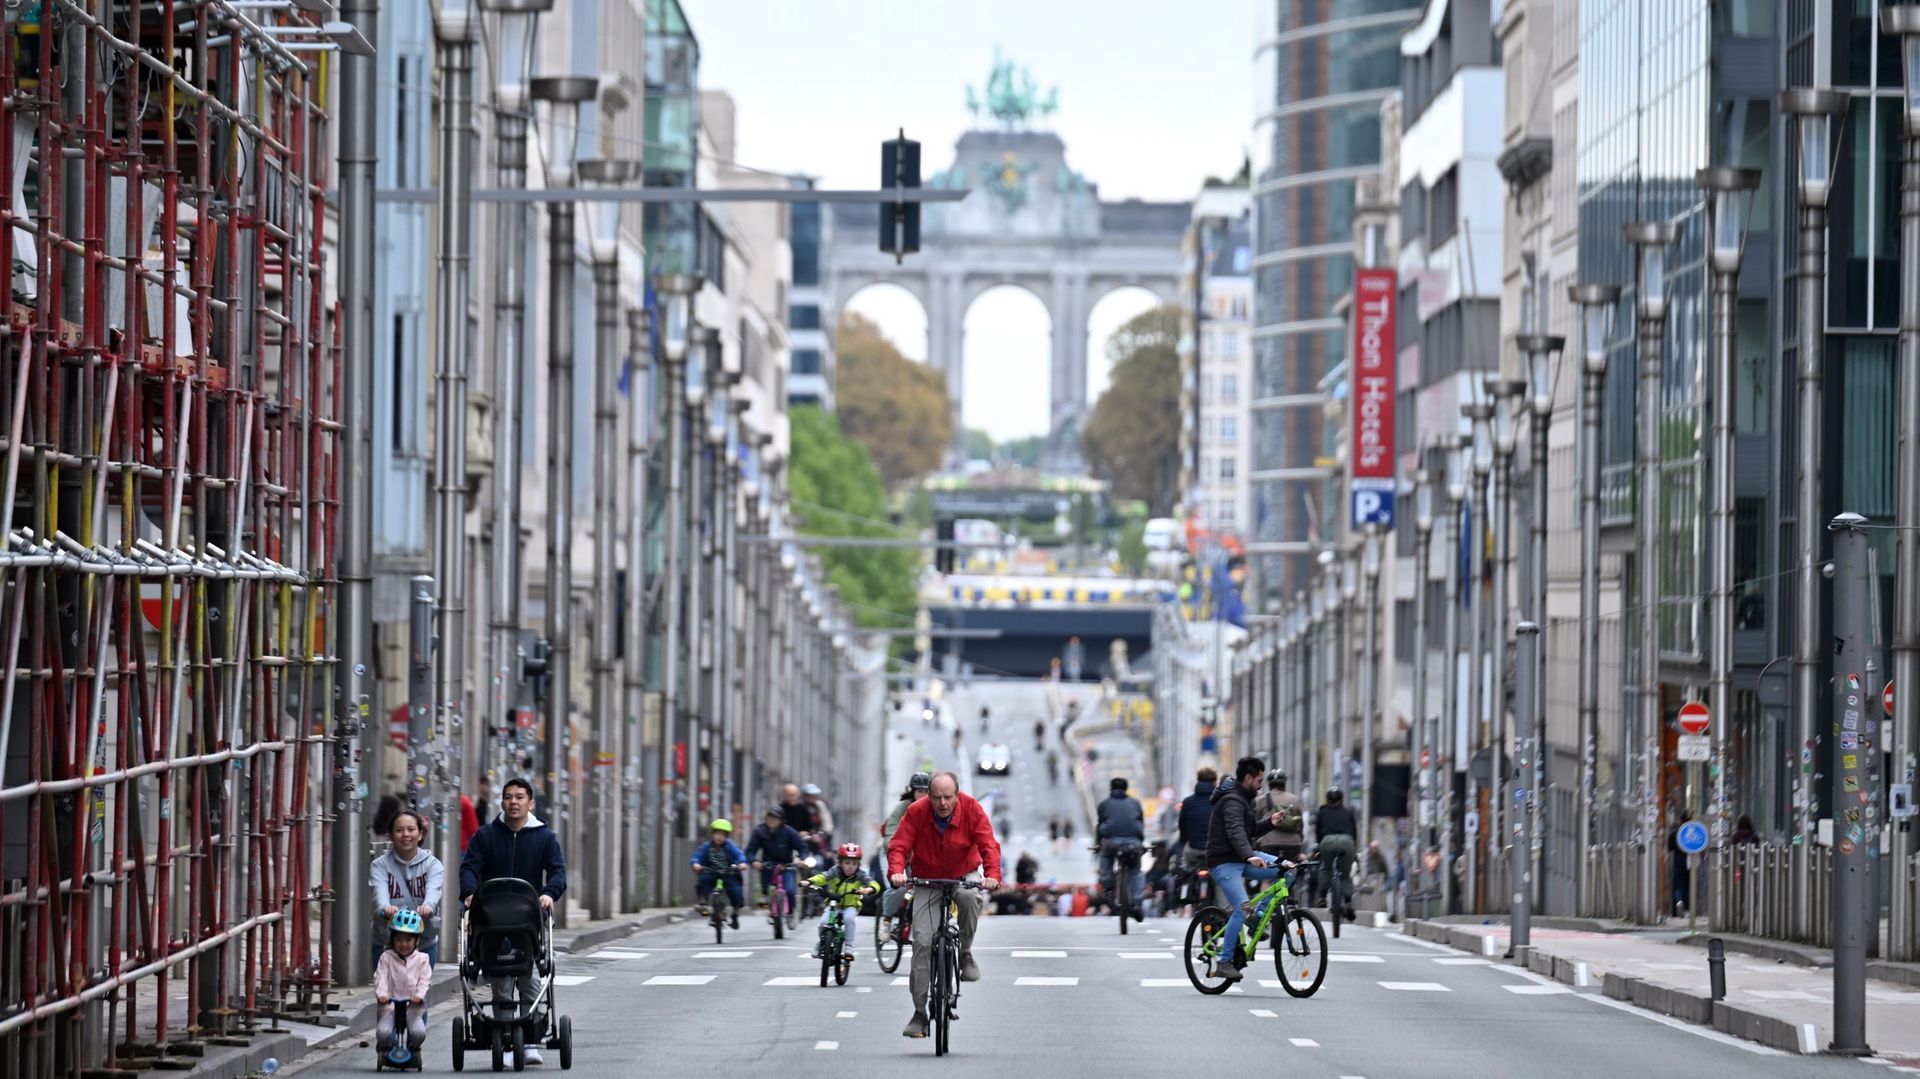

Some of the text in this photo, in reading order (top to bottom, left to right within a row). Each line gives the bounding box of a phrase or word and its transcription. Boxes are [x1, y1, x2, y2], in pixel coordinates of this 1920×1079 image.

[1362, 295, 1389, 369] Thon
[1360, 377, 1387, 468] Hotels
[1356, 486, 1381, 523] P
